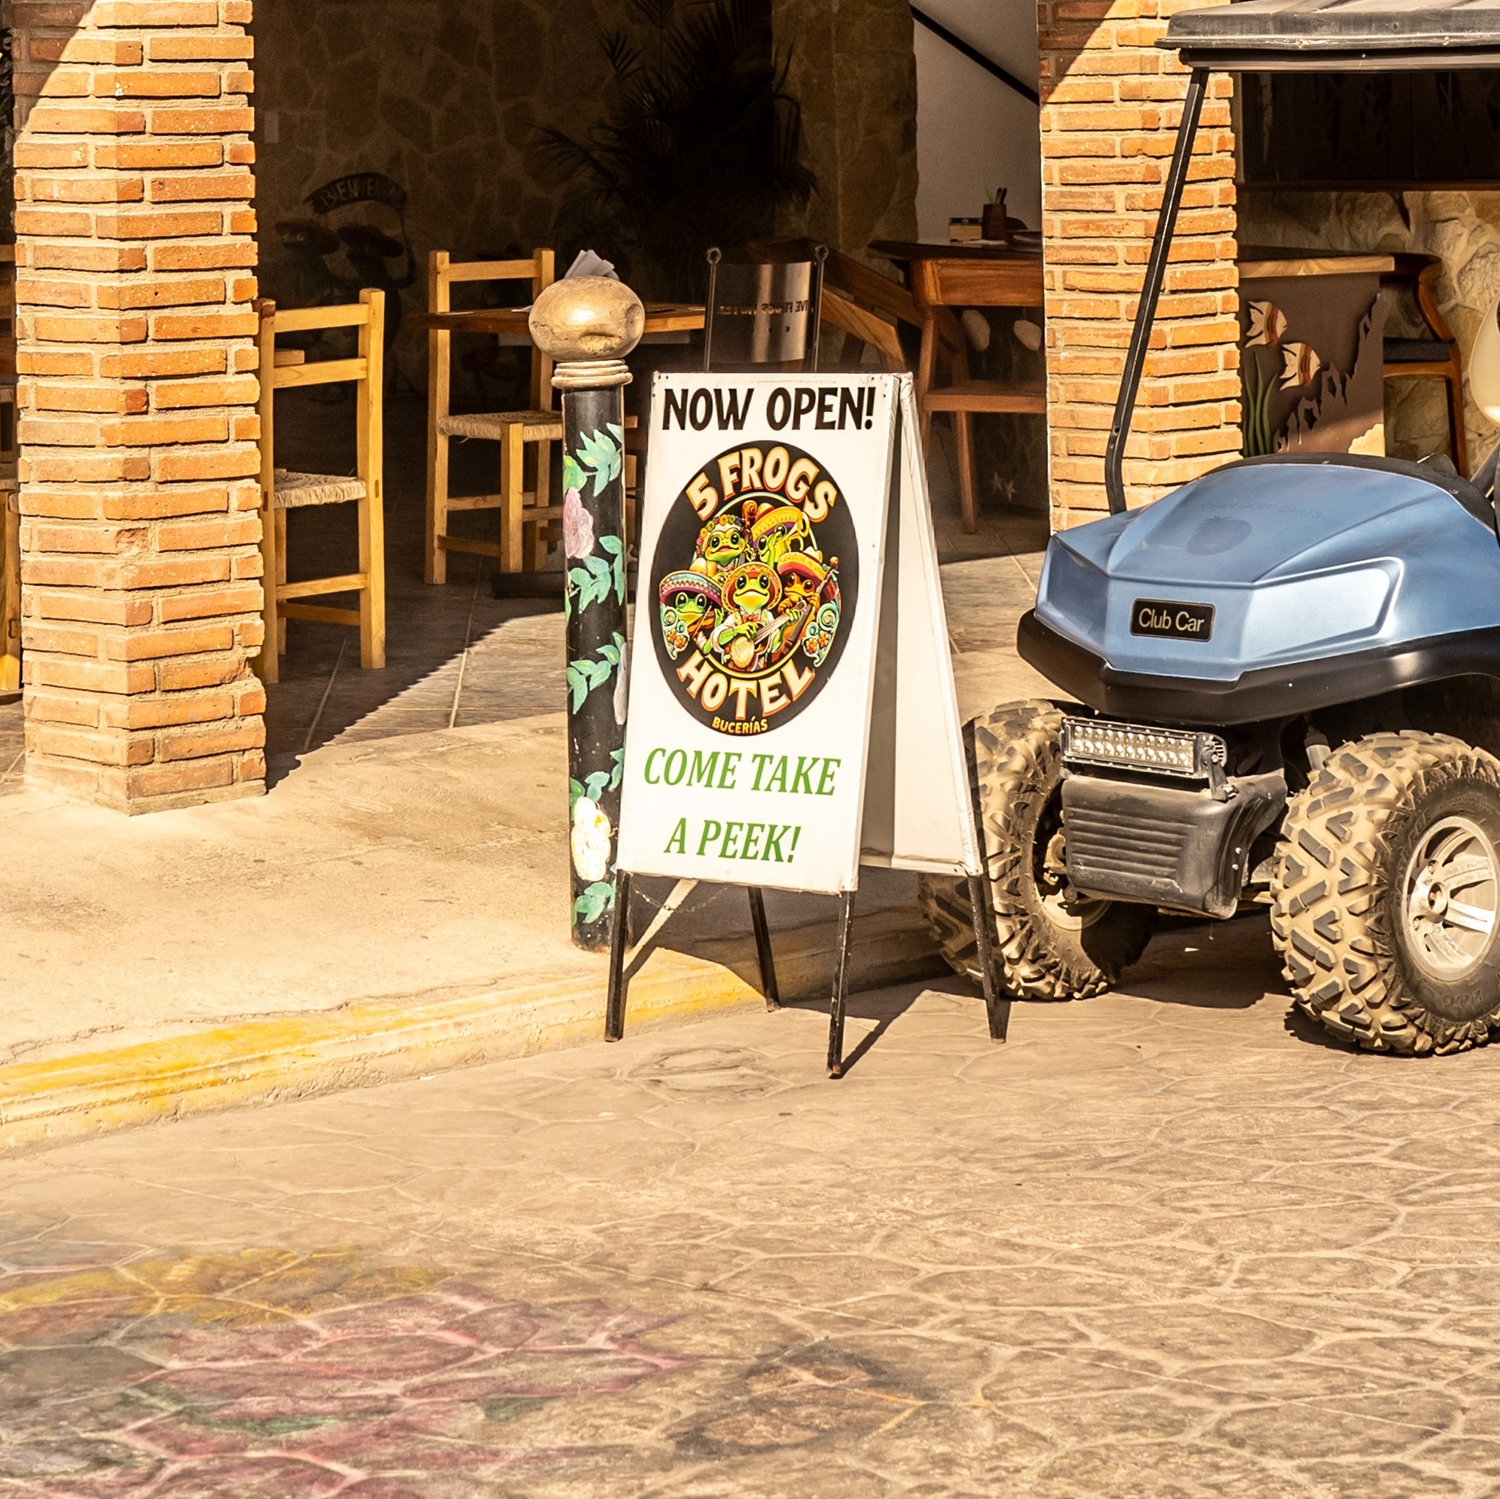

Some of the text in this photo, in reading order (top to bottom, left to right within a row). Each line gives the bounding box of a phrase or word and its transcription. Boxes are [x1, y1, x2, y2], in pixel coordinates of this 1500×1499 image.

[662, 386, 875, 431] NOW OPEN!
[685, 446, 838, 525] 5 FROGS
[1138, 607, 1205, 632] Club Car
[676, 653, 815, 721] HOTEL
[712, 716, 768, 734] BUCERÍAS
[643, 747, 842, 797] COME TAKE
[664, 820, 802, 864] A PEEK!
